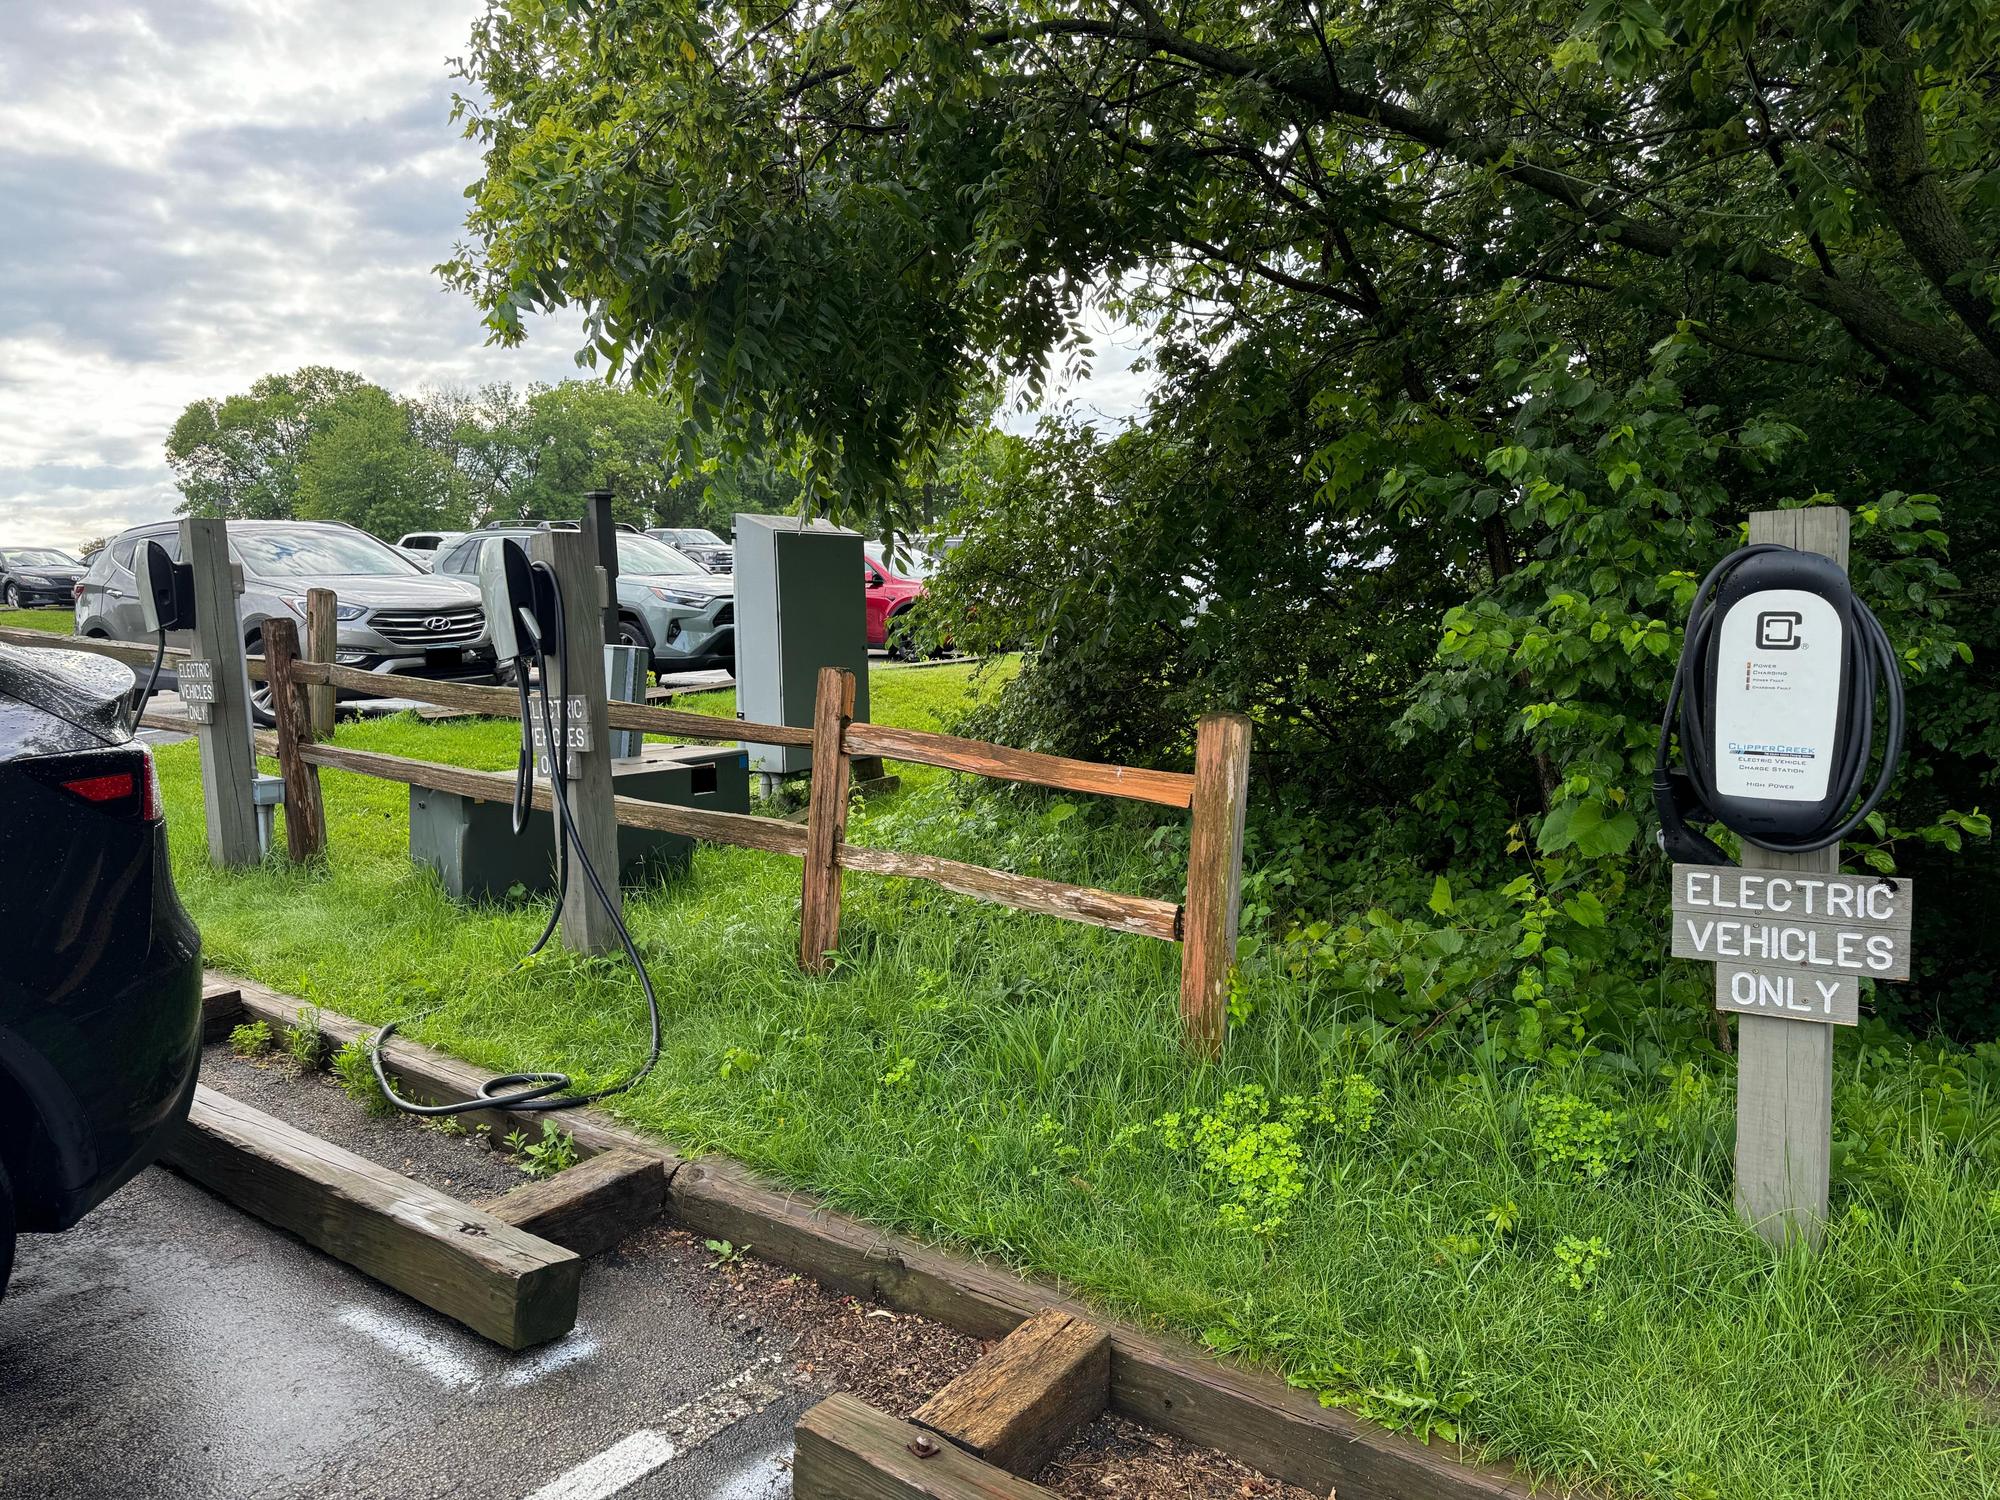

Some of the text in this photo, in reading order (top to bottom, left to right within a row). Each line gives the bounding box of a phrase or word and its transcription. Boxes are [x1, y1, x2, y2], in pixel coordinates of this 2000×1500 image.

[178, 662, 210, 678] ELECTRIC
[180, 684, 212, 700] VEHICLES
[190, 706, 207, 720] ONLY
[1738, 756, 1807, 766] ELECTRIC VEHICLE
[1738, 764, 1804, 774] CHARGE STATION
[1768, 782, 1795, 790] POWER
[1687, 872, 1894, 920] ELECTRIC
[1687, 919, 1893, 970] VEHICLES
[1731, 971, 1841, 1014] ONLY
